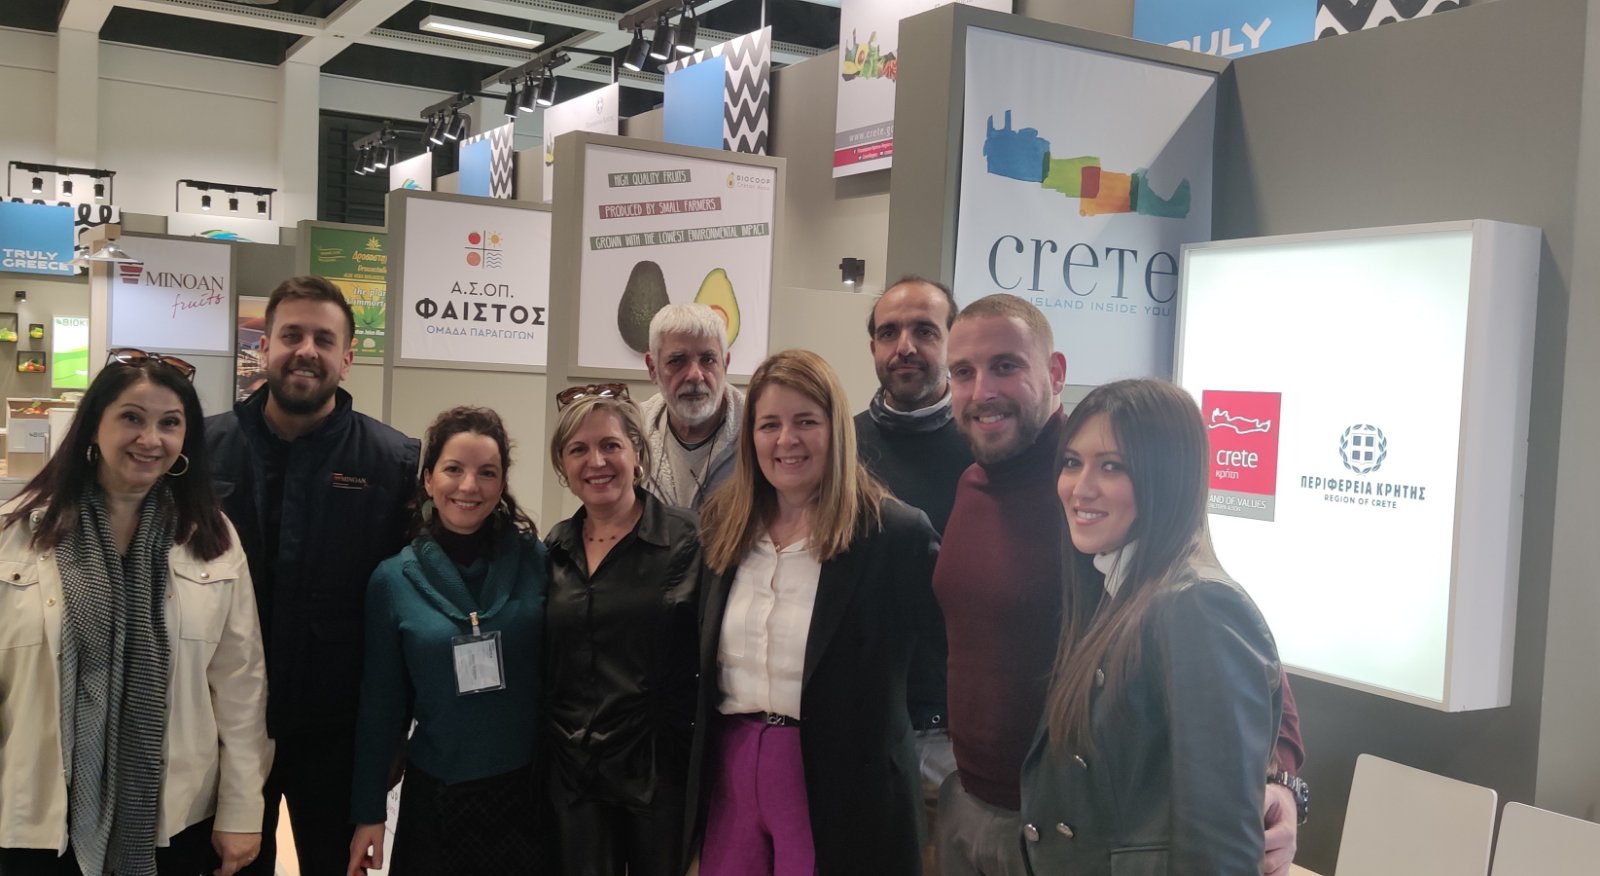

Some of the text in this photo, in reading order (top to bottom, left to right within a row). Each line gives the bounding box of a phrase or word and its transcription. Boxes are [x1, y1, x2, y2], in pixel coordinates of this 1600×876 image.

[613, 170, 687, 186] HIGH QUALITY FRUITS
[736, 175, 771, 184] BIOCOOP
[605, 198, 716, 218] PRODUCED BY SMALL FARMERS
[595, 224, 765, 249] GROWN WITH THE LOWEST ENVIRONMENTAL IMPACT
[2, 248, 59, 260] TRULY
[2, 258, 70, 271] GREECE
[145, 271, 224, 291] MINOAN
[172, 289, 225, 319] fruits
[415, 297, 545, 326] ΦΑΙΣΤΟΣ
[1030, 297, 1171, 317] ISLAND INSIDE YOU
[426, 325, 534, 340] ΟΜΑΔΑ ΠΑΡΑΓΩΓΩΝ
[1216, 449, 1259, 468] crete
[1300, 475, 1426, 501] ΠΕΡΙΦΕΡΕΙΑ ΚΡΗΤΗΣ
[1209, 494, 1225, 504] AND
[1324, 494, 1397, 509] REGION OF CRETE
